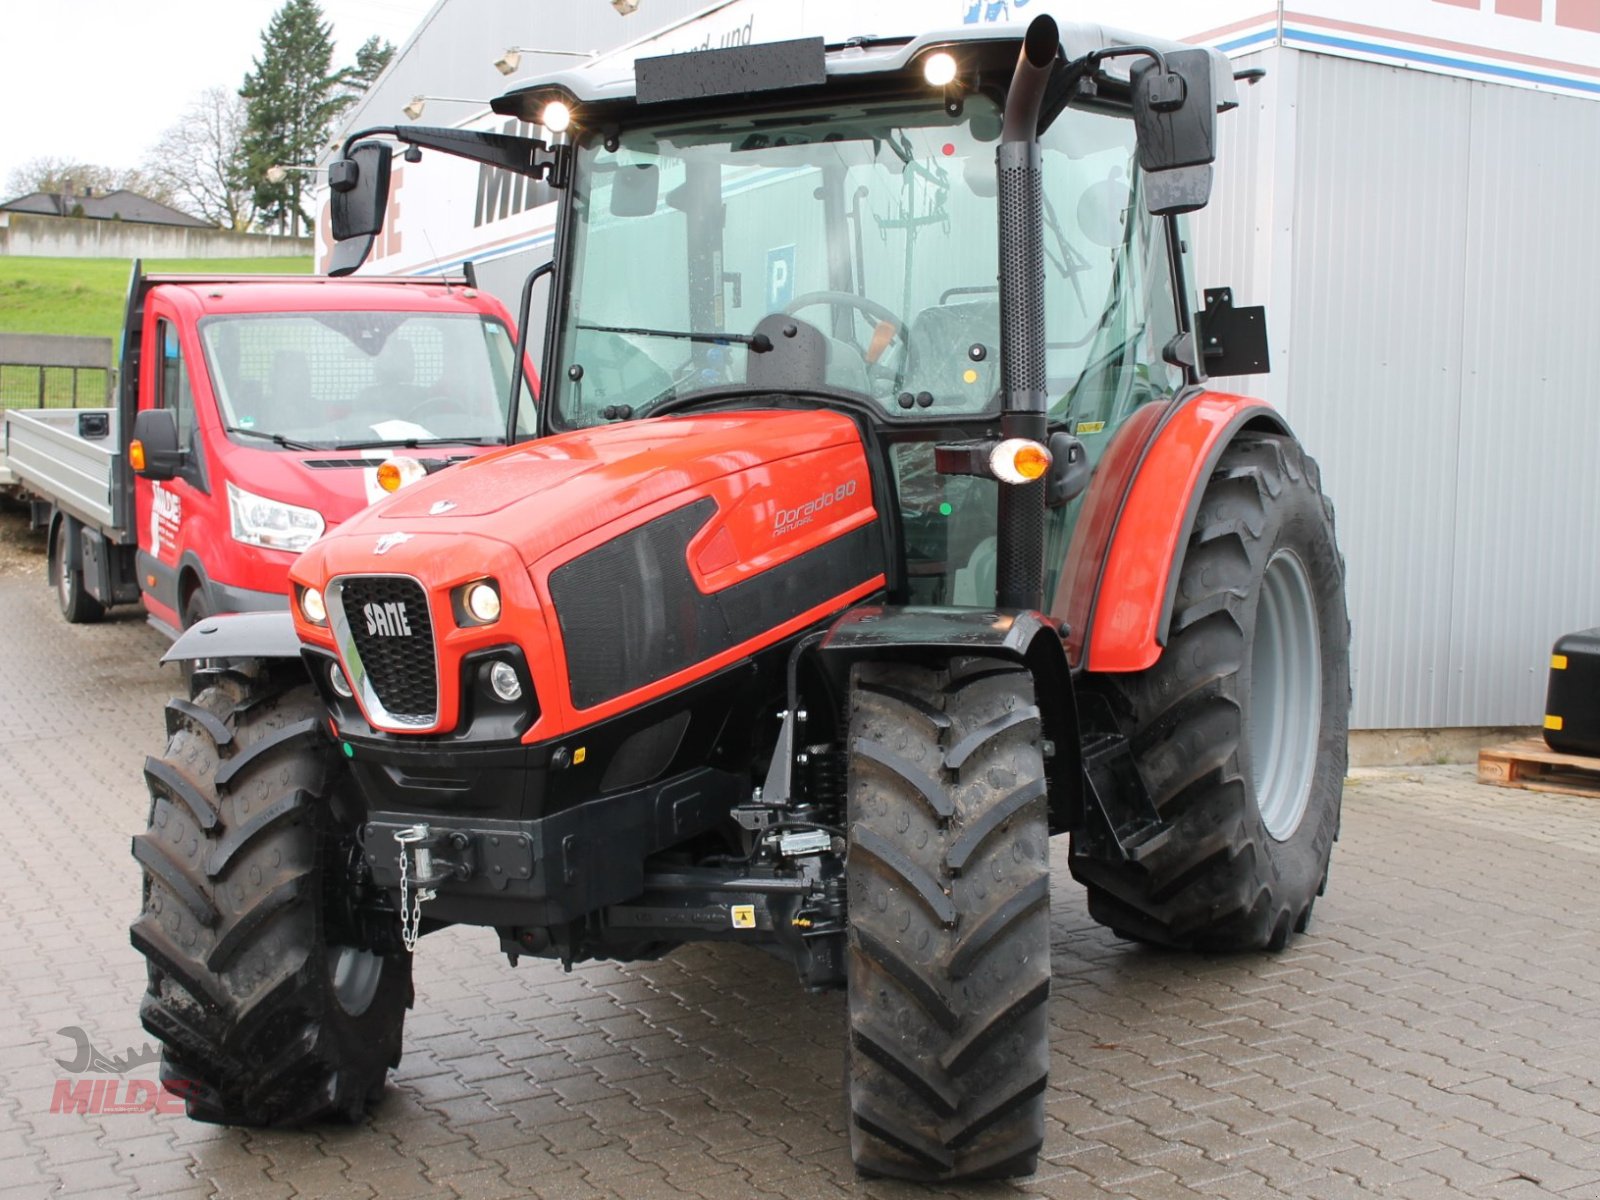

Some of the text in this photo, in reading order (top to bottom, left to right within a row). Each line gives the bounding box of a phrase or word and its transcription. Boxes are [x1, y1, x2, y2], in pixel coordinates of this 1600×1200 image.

[719, 13, 754, 48] und
[772, 259, 788, 303] P
[774, 479, 857, 529] Dorado 80
[363, 601, 412, 637] SAME
